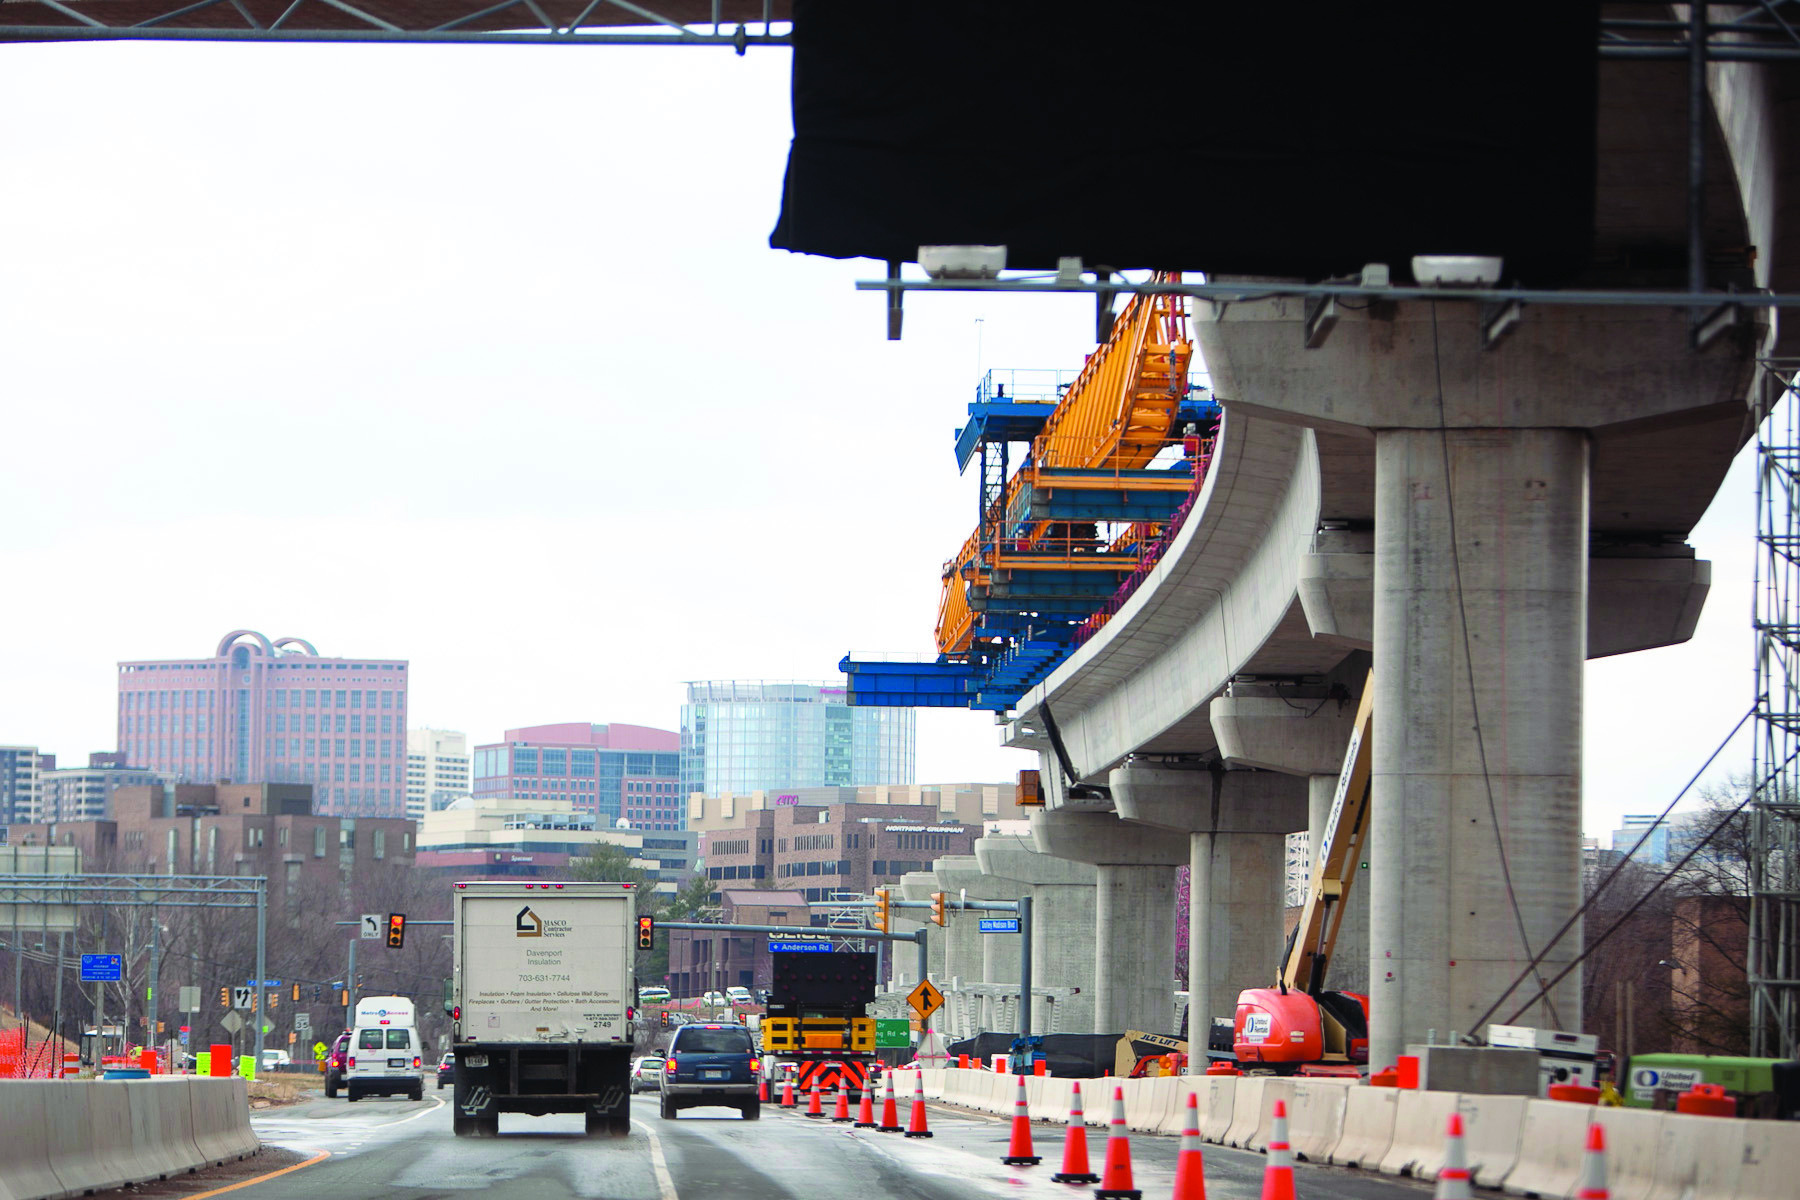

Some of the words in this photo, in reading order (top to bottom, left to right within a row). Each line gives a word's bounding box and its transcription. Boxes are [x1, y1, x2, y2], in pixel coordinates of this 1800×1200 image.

[776, 795, 799, 805] amc
[518, 974, 570, 982] 703-631-7744
[1255, 1017, 1268, 1025] United
[1140, 1034, 1158, 1042] JLG
[1159, 1038, 1180, 1047] LIFT
[1661, 1071, 1695, 1080] United
[1661, 1080, 1692, 1089] Rental
